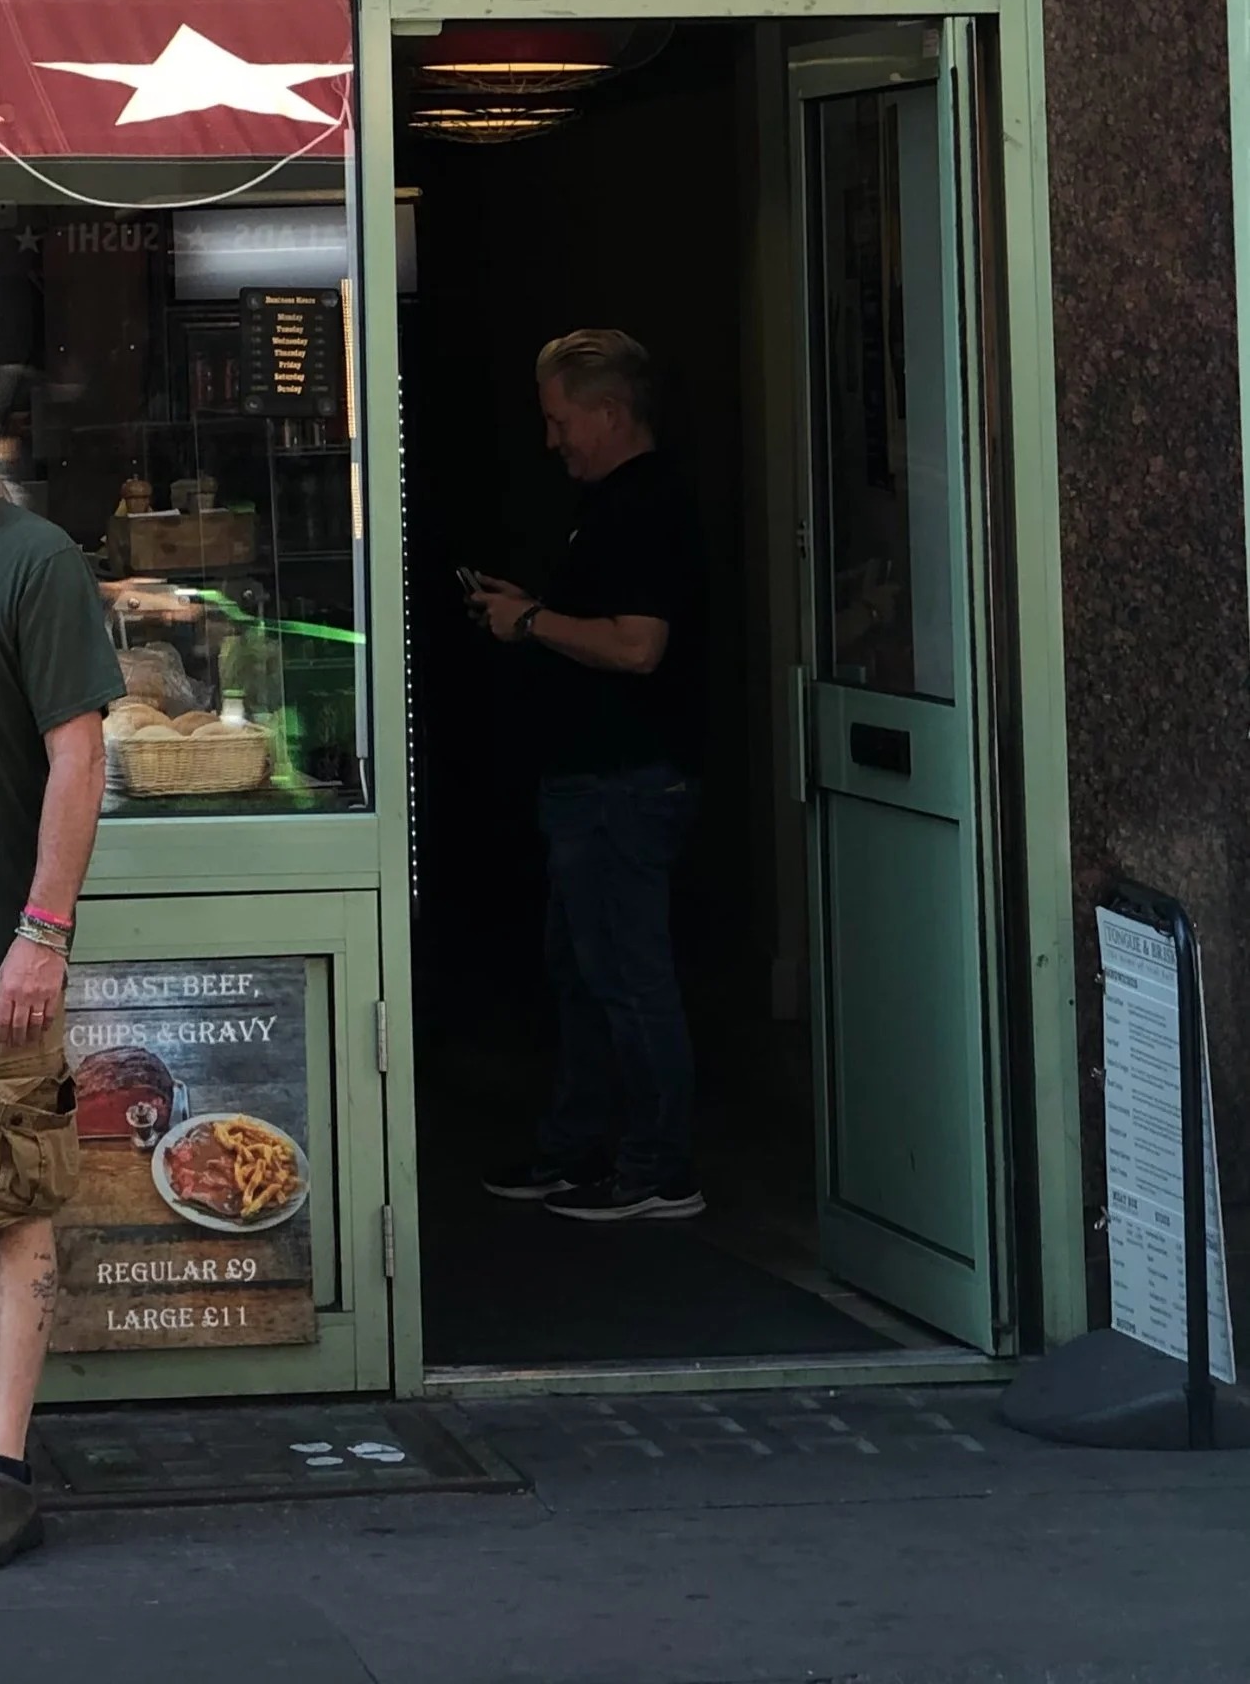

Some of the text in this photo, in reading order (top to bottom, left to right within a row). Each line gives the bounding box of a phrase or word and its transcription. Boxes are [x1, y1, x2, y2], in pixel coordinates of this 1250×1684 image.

[83, 973, 260, 1002] ROAST BEEF,
[69, 1016, 278, 1048] CHIPS & GRAVY
[97, 1258, 257, 1285] REGULAR £9
[107, 1306, 249, 1331] LARGE £11
